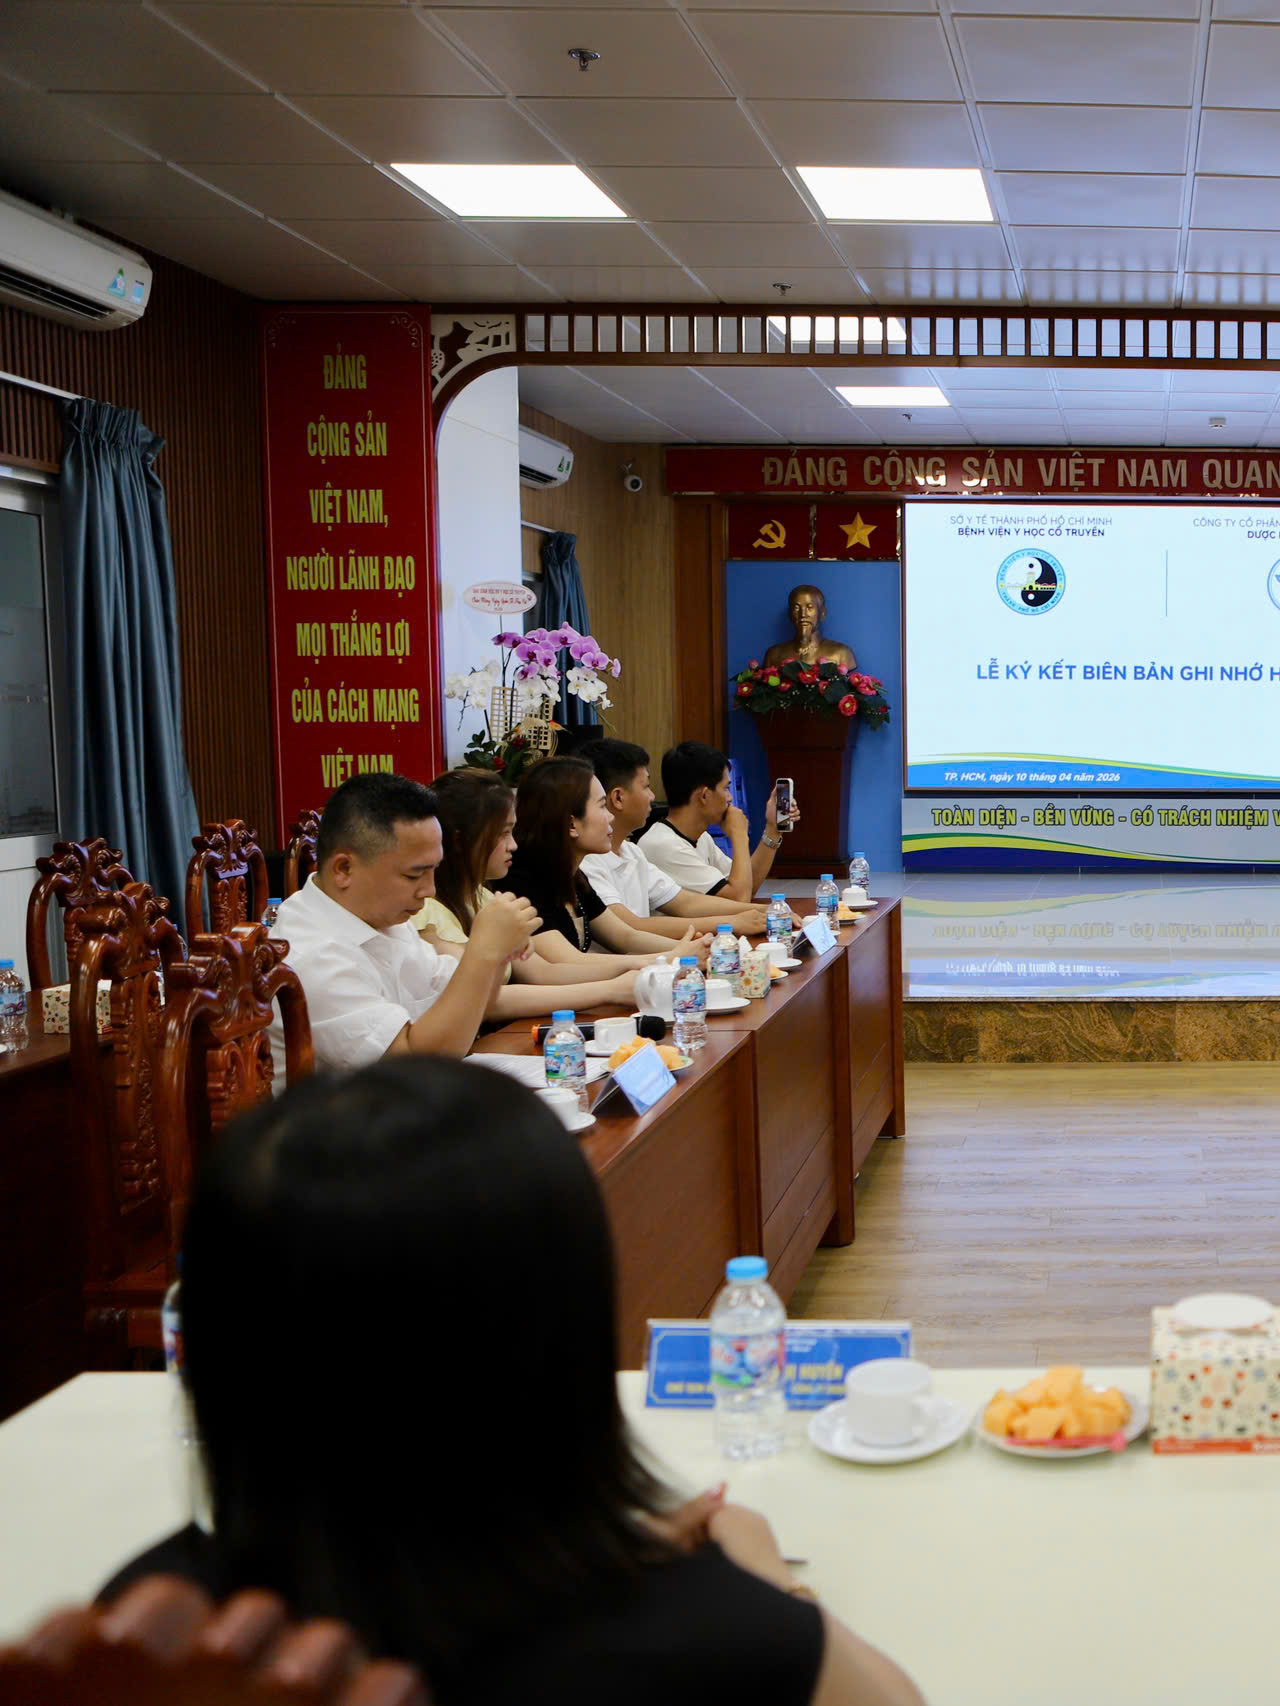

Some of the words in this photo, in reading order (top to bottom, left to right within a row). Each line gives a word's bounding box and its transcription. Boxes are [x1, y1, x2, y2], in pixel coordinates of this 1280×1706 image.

[323, 342, 367, 389] ĐẢNG
[307, 414, 351, 464] CỘNG
[355, 410, 387, 457] SẢN
[762, 449, 848, 486] ĐẢNG
[863, 450, 947, 491] CỘNG
[962, 449, 1023, 487] SẢN
[1037, 451, 1105, 492] VIỆT
[1118, 458, 1187, 488] NAM
[309, 481, 342, 531] VIỆT
[346, 489, 388, 528] NAM,
[967, 516, 973, 525] Y
[1087, 517, 1113, 526] MINH
[1193, 517, 1222, 527] CÔNG
[1225, 518, 1236, 527] TY
[958, 526, 985, 538] BỆNH
[988, 526, 1011, 538] VIỆN
[1014, 528, 1021, 536] Y
[1023, 528, 1045, 539] HỌC
[1048, 525, 1063, 537] CỔ
[1066, 526, 1105, 537] TRUYỀN
[1247, 530, 1276, 541] DƯỢC
[286, 547, 335, 590] NGƯỜI
[339, 549, 380, 590] LÃNH
[383, 555, 416, 598] ĐẠO
[296, 622, 327, 664] MỌI
[330, 609, 382, 657] THẮNG
[386, 618, 410, 664] LỢI
[976, 658, 999, 680] LỄ
[1006, 661, 1031, 680] KÝ
[1039, 659, 1076, 680] KẾT
[1083, 662, 1126, 681] BIÊN
[1134, 661, 1174, 681] BẢN
[1180, 666, 1213, 681] GHI
[1220, 662, 1263, 682] NHỚ
[291, 677, 323, 723] CỦA
[327, 681, 368, 723] CÁCH
[373, 688, 419, 730] MẠNG
[944, 773, 957, 781] TP.
[960, 773, 987, 782] HCM,
[990, 772, 1014, 783] ngày
[1016, 773, 1026, 781] 10
[1029, 772, 1057, 783] tháng
[1059, 773, 1071, 782] 04
[1074, 773, 1094, 782] năm
[1096, 773, 1120, 782] 2026
[932, 804, 975, 826] TOÀN
[979, 804, 1017, 829] DIỆN
[1033, 802, 1066, 826] BỀN
[1070, 804, 1115, 826] VỮNG
[1131, 804, 1154, 827] CÓ
[1157, 804, 1211, 827] TRÁCH
[1216, 805, 1269, 830] NHIỆM
